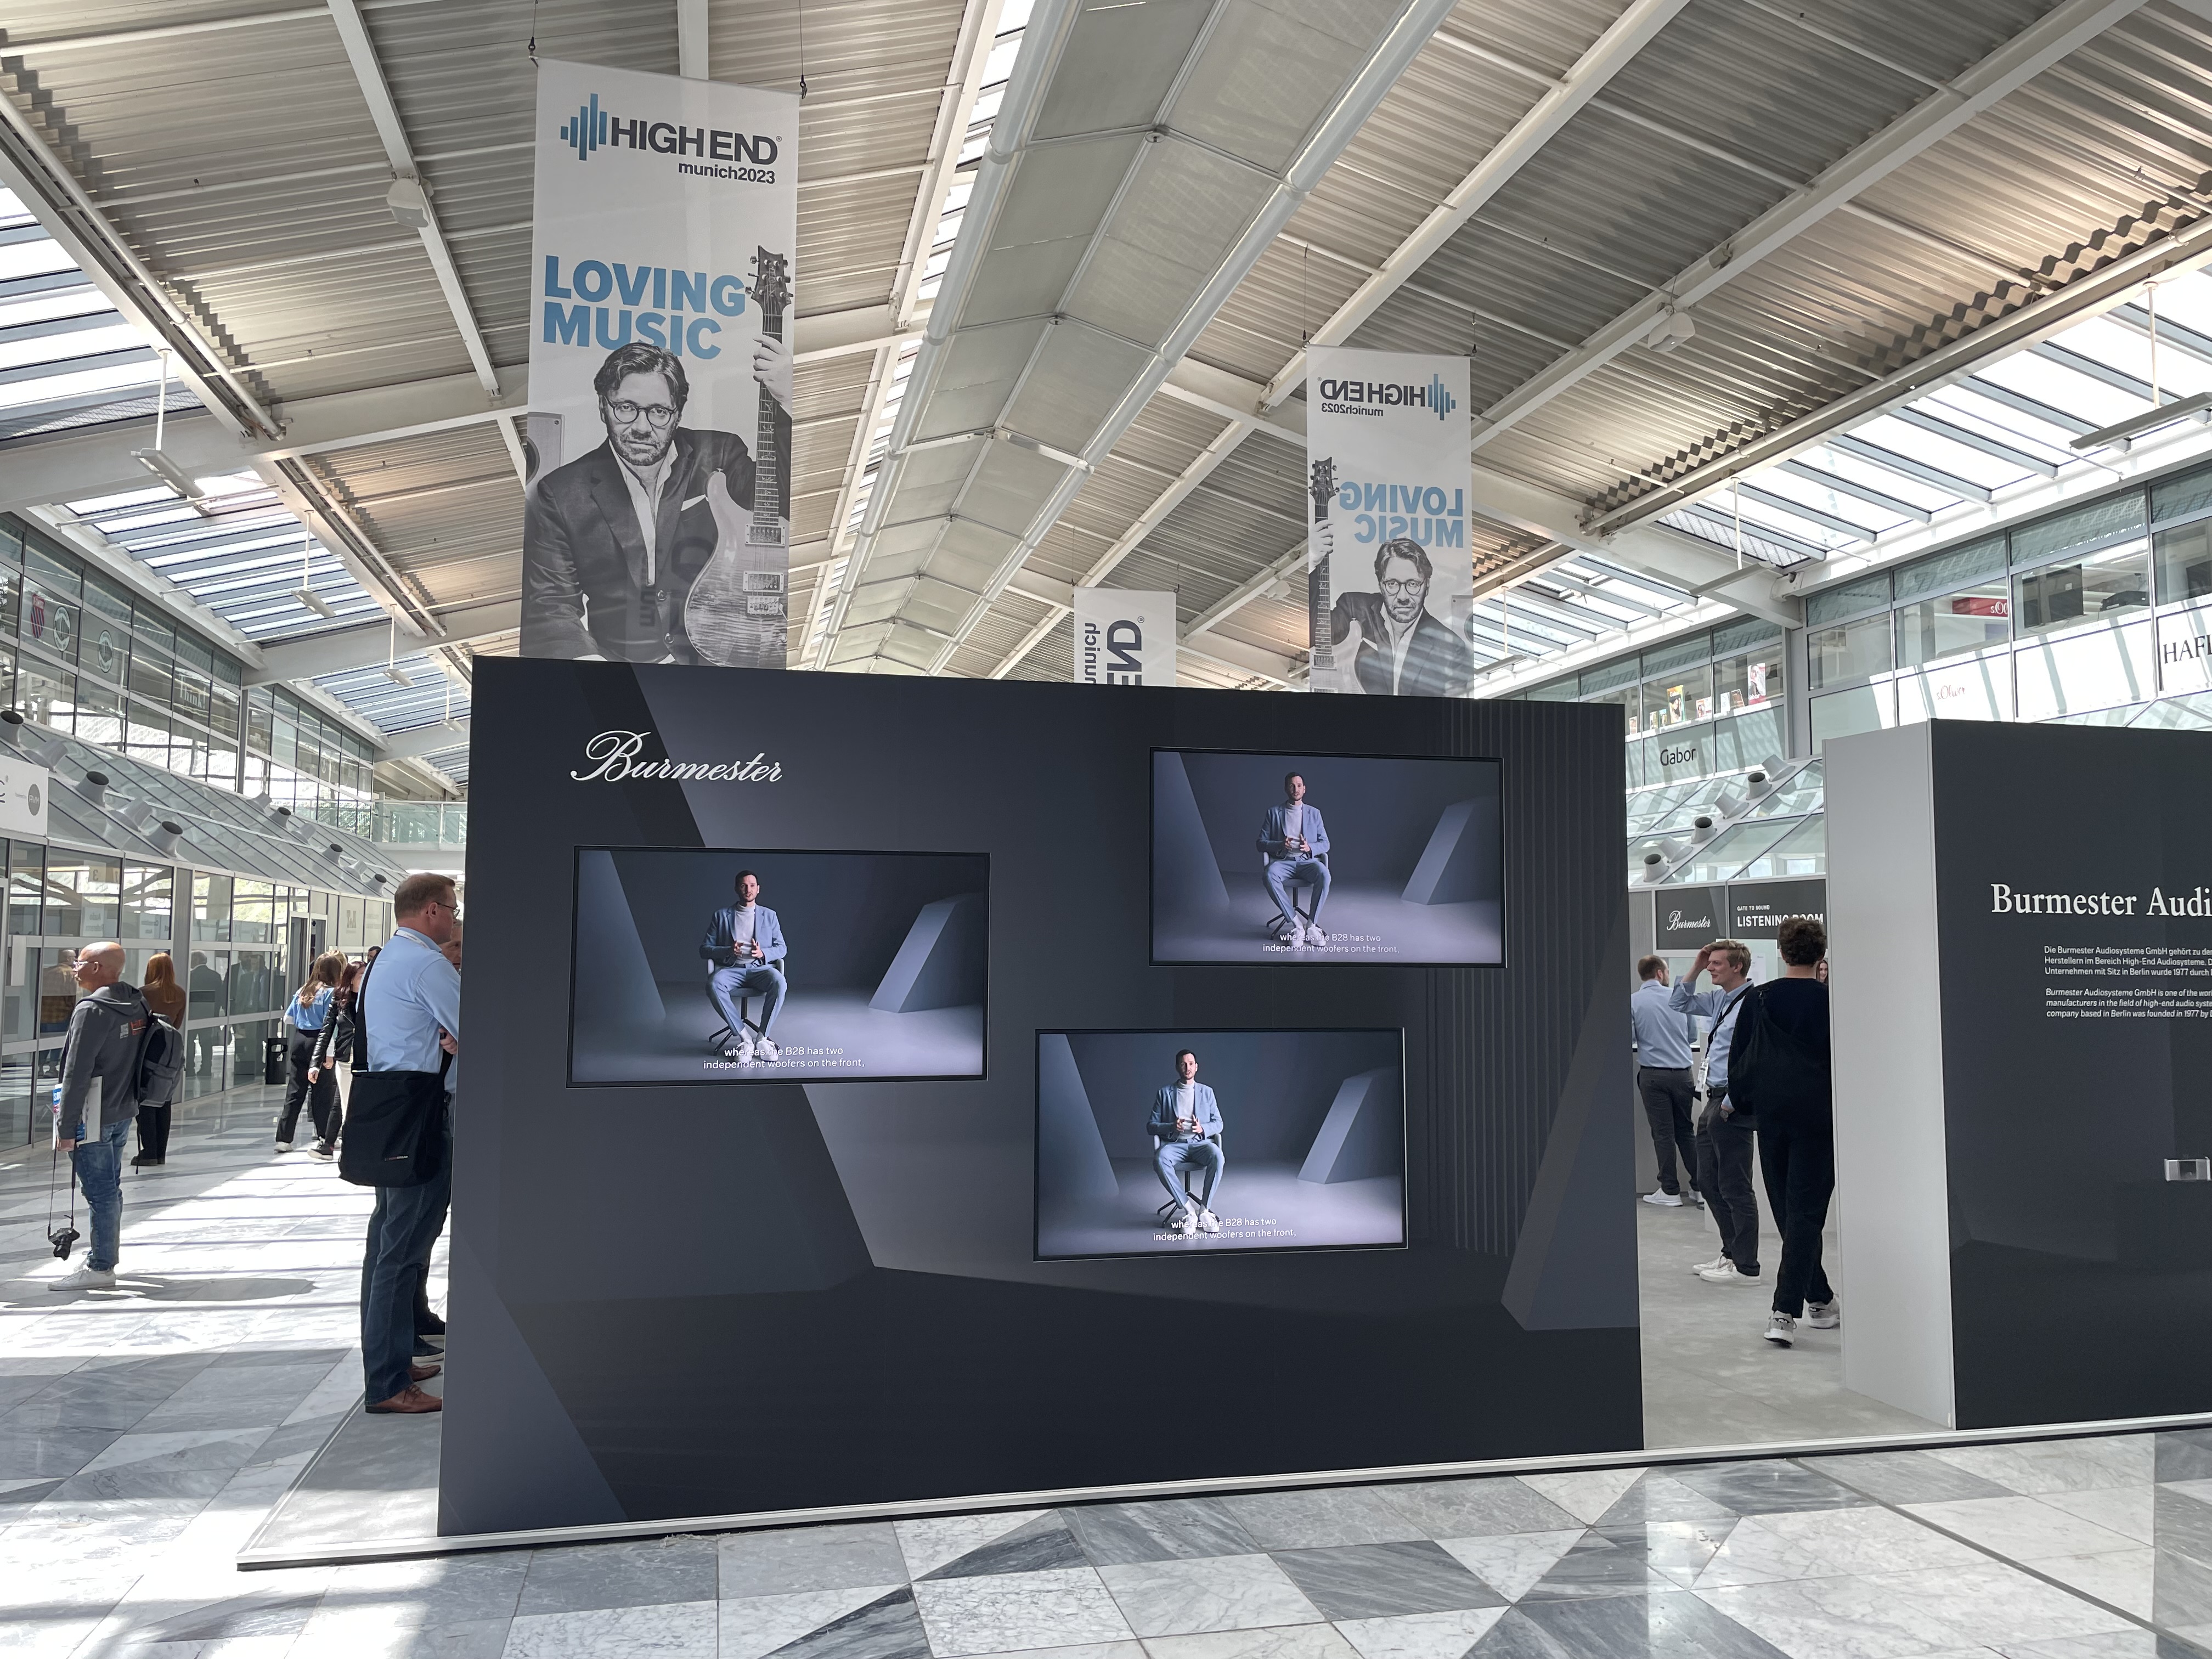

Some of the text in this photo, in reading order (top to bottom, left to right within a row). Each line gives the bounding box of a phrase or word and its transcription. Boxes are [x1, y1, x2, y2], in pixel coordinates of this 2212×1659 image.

[611, 117, 704, 157] HIGH
[678, 162, 775, 184] munich2023
[545, 255, 745, 317] LOVING
[543, 301, 723, 360] MUSIC
[571, 730, 782, 782] Burmester
[1660, 747, 1696, 766] Gabor
[1990, 884, 2212, 917] Burmester Audi
[1667, 910, 1711, 931] Burmester
[1331, 933, 1348, 941] B28
[1262, 944, 1314, 953] independent
[1317, 944, 1348, 952] woofers
[1363, 944, 1376, 952] the
[2096, 946, 2144, 956] Audiosysteme
[2169, 947, 2191, 956] gehört
[2123, 957, 2155, 966] High-End
[2157, 957, 2207, 967] Audiosysteme.
[2045, 967, 2092, 975] Unternehmen
[2084, 988, 2133, 997] Audiosysteme
[2143, 999, 2174, 1008] high-end
[2200, 1010, 2209, 1018] by
[786, 1047, 805, 1056] B28
[807, 1047, 823, 1055] has
[703, 1060, 765, 1070] independent
[768, 1059, 805, 1068] woofers
[1225, 1218, 1243, 1227] B28
[1244, 1217, 1260, 1226] has
[1153, 1232, 1207, 1242] independent
[1210, 1231, 1244, 1239] woofers
